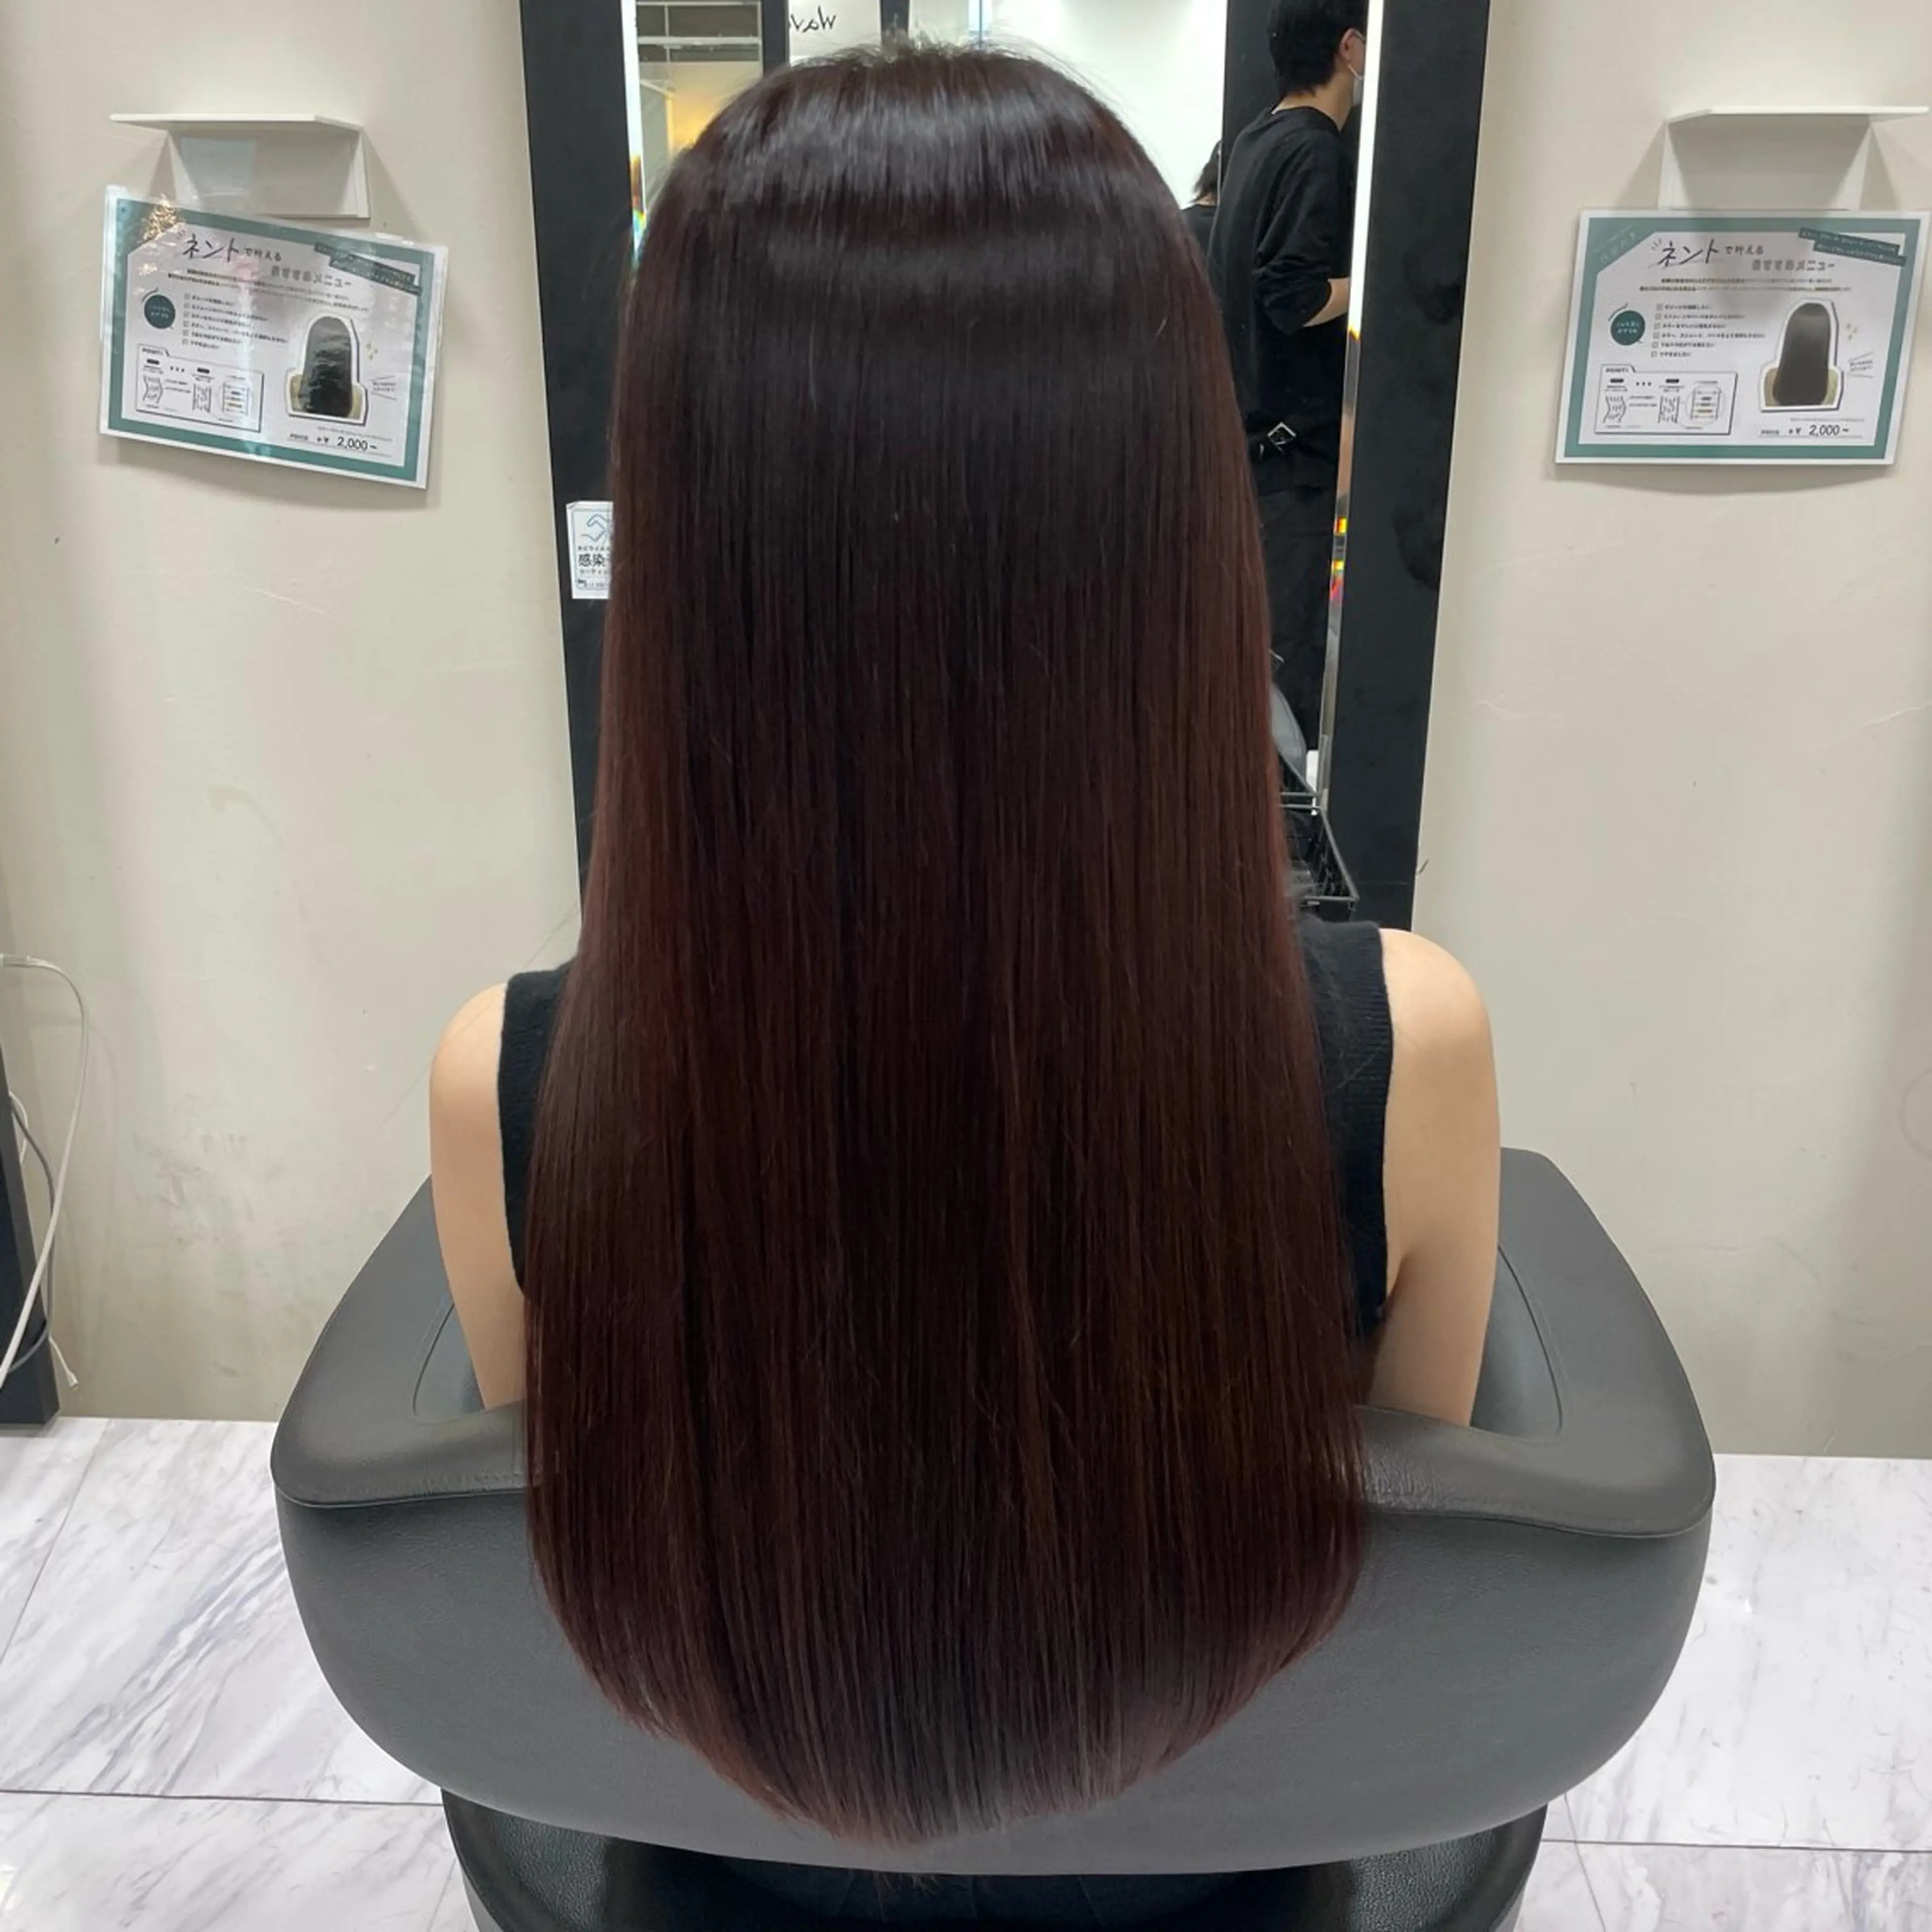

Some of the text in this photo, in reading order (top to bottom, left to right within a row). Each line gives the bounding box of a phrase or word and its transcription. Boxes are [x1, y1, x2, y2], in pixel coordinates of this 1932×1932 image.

[182, 233, 239, 263] ネント
[1658, 238, 1719, 267] ネント
[578, 553, 610, 568] 感染
